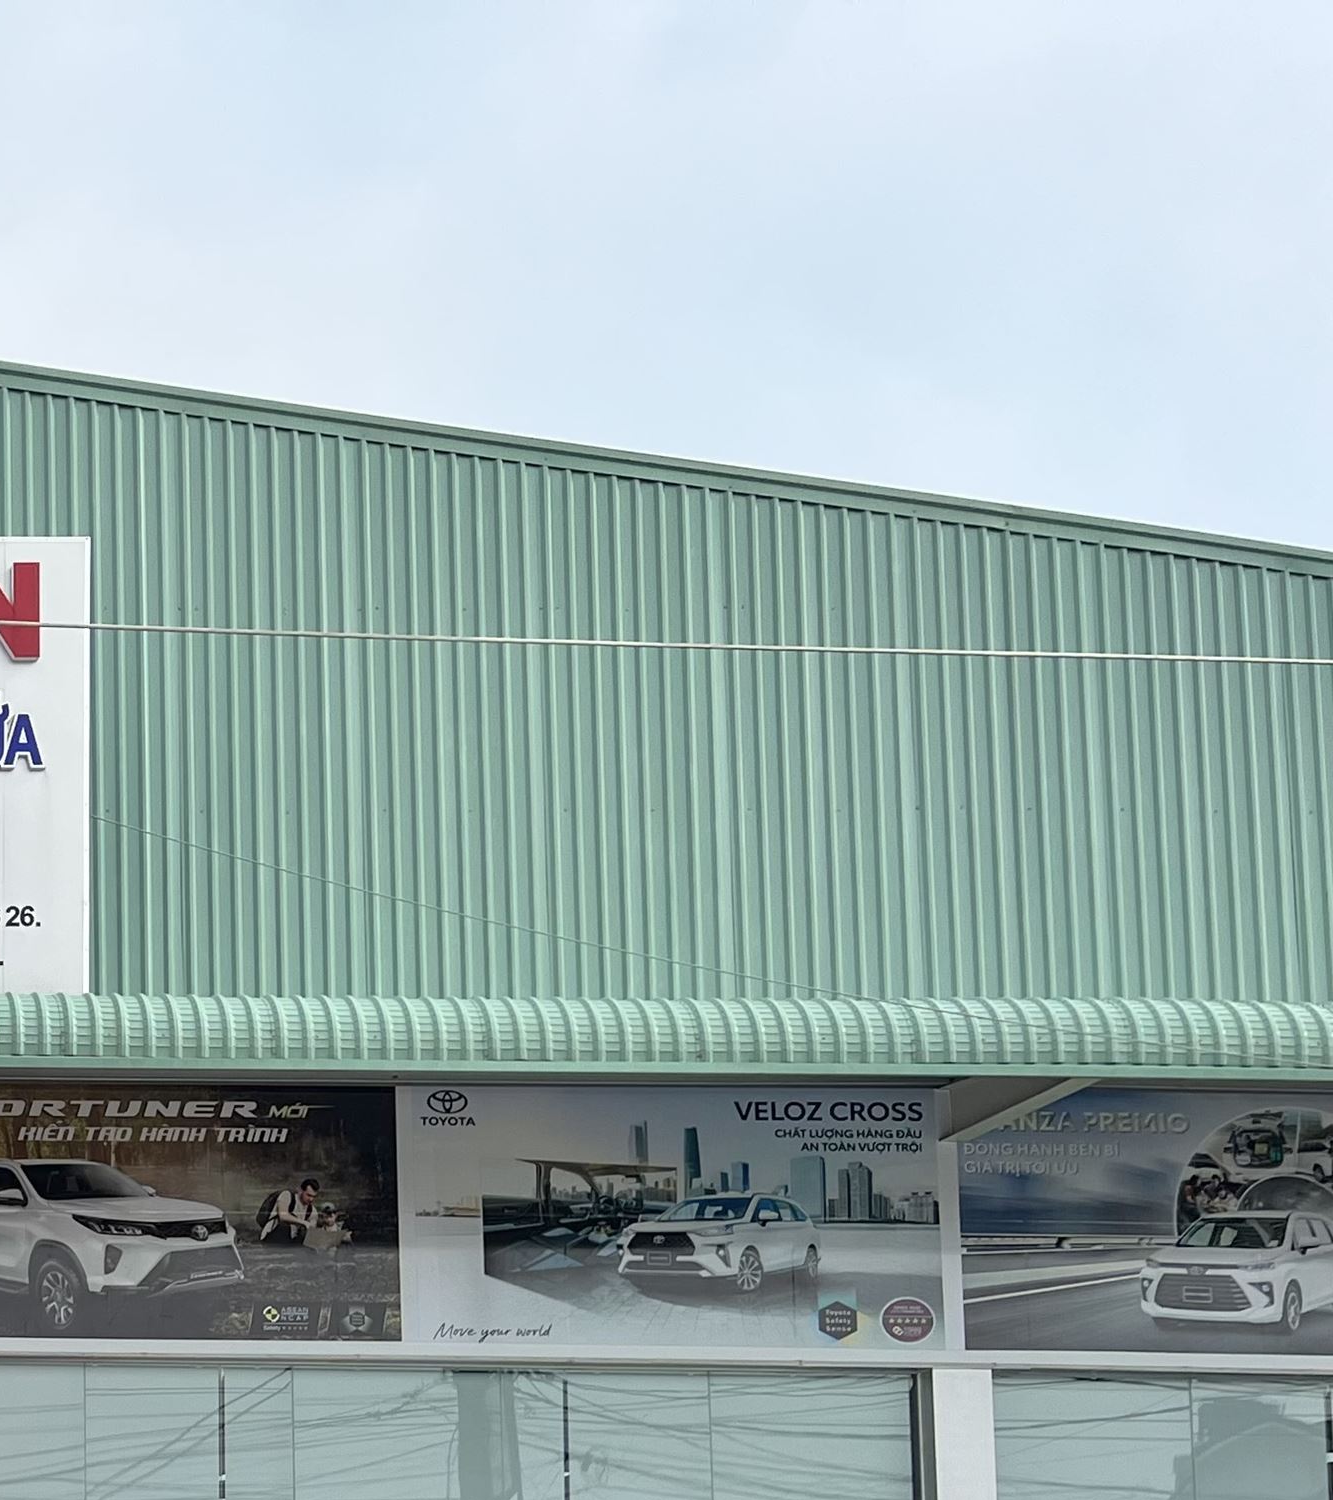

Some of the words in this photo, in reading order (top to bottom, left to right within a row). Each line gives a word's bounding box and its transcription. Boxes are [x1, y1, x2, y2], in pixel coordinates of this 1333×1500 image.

[5, 905, 42, 928] 26.
[265, 1102, 311, 1119] MỚI
[420, 1116, 476, 1126] TOYOTA
[733, 1101, 823, 1121] VELOZ
[829, 1101, 923, 1122] CROSS
[18, 1120, 76, 1142] KIẾN
[139, 1123, 208, 1143] HÀNH
[215, 1123, 288, 1143] TRÌNH
[1084, 1111, 1191, 1134] PREMIO
[775, 1127, 807, 1138] CHẤT
[809, 1128, 854, 1141] LƯỢNG
[856, 1127, 894, 1139] HÀNG
[896, 1127, 922, 1139] ĐẦU
[801, 1142, 819, 1152] AN
[822, 1140, 856, 1152] TOÀN
[858, 1141, 893, 1155] VƯỢT
[894, 1141, 922, 1154] TRỘI
[433, 1322, 476, 1340] Move
[478, 1328, 512, 1344] your
[516, 1322, 553, 1337] world
